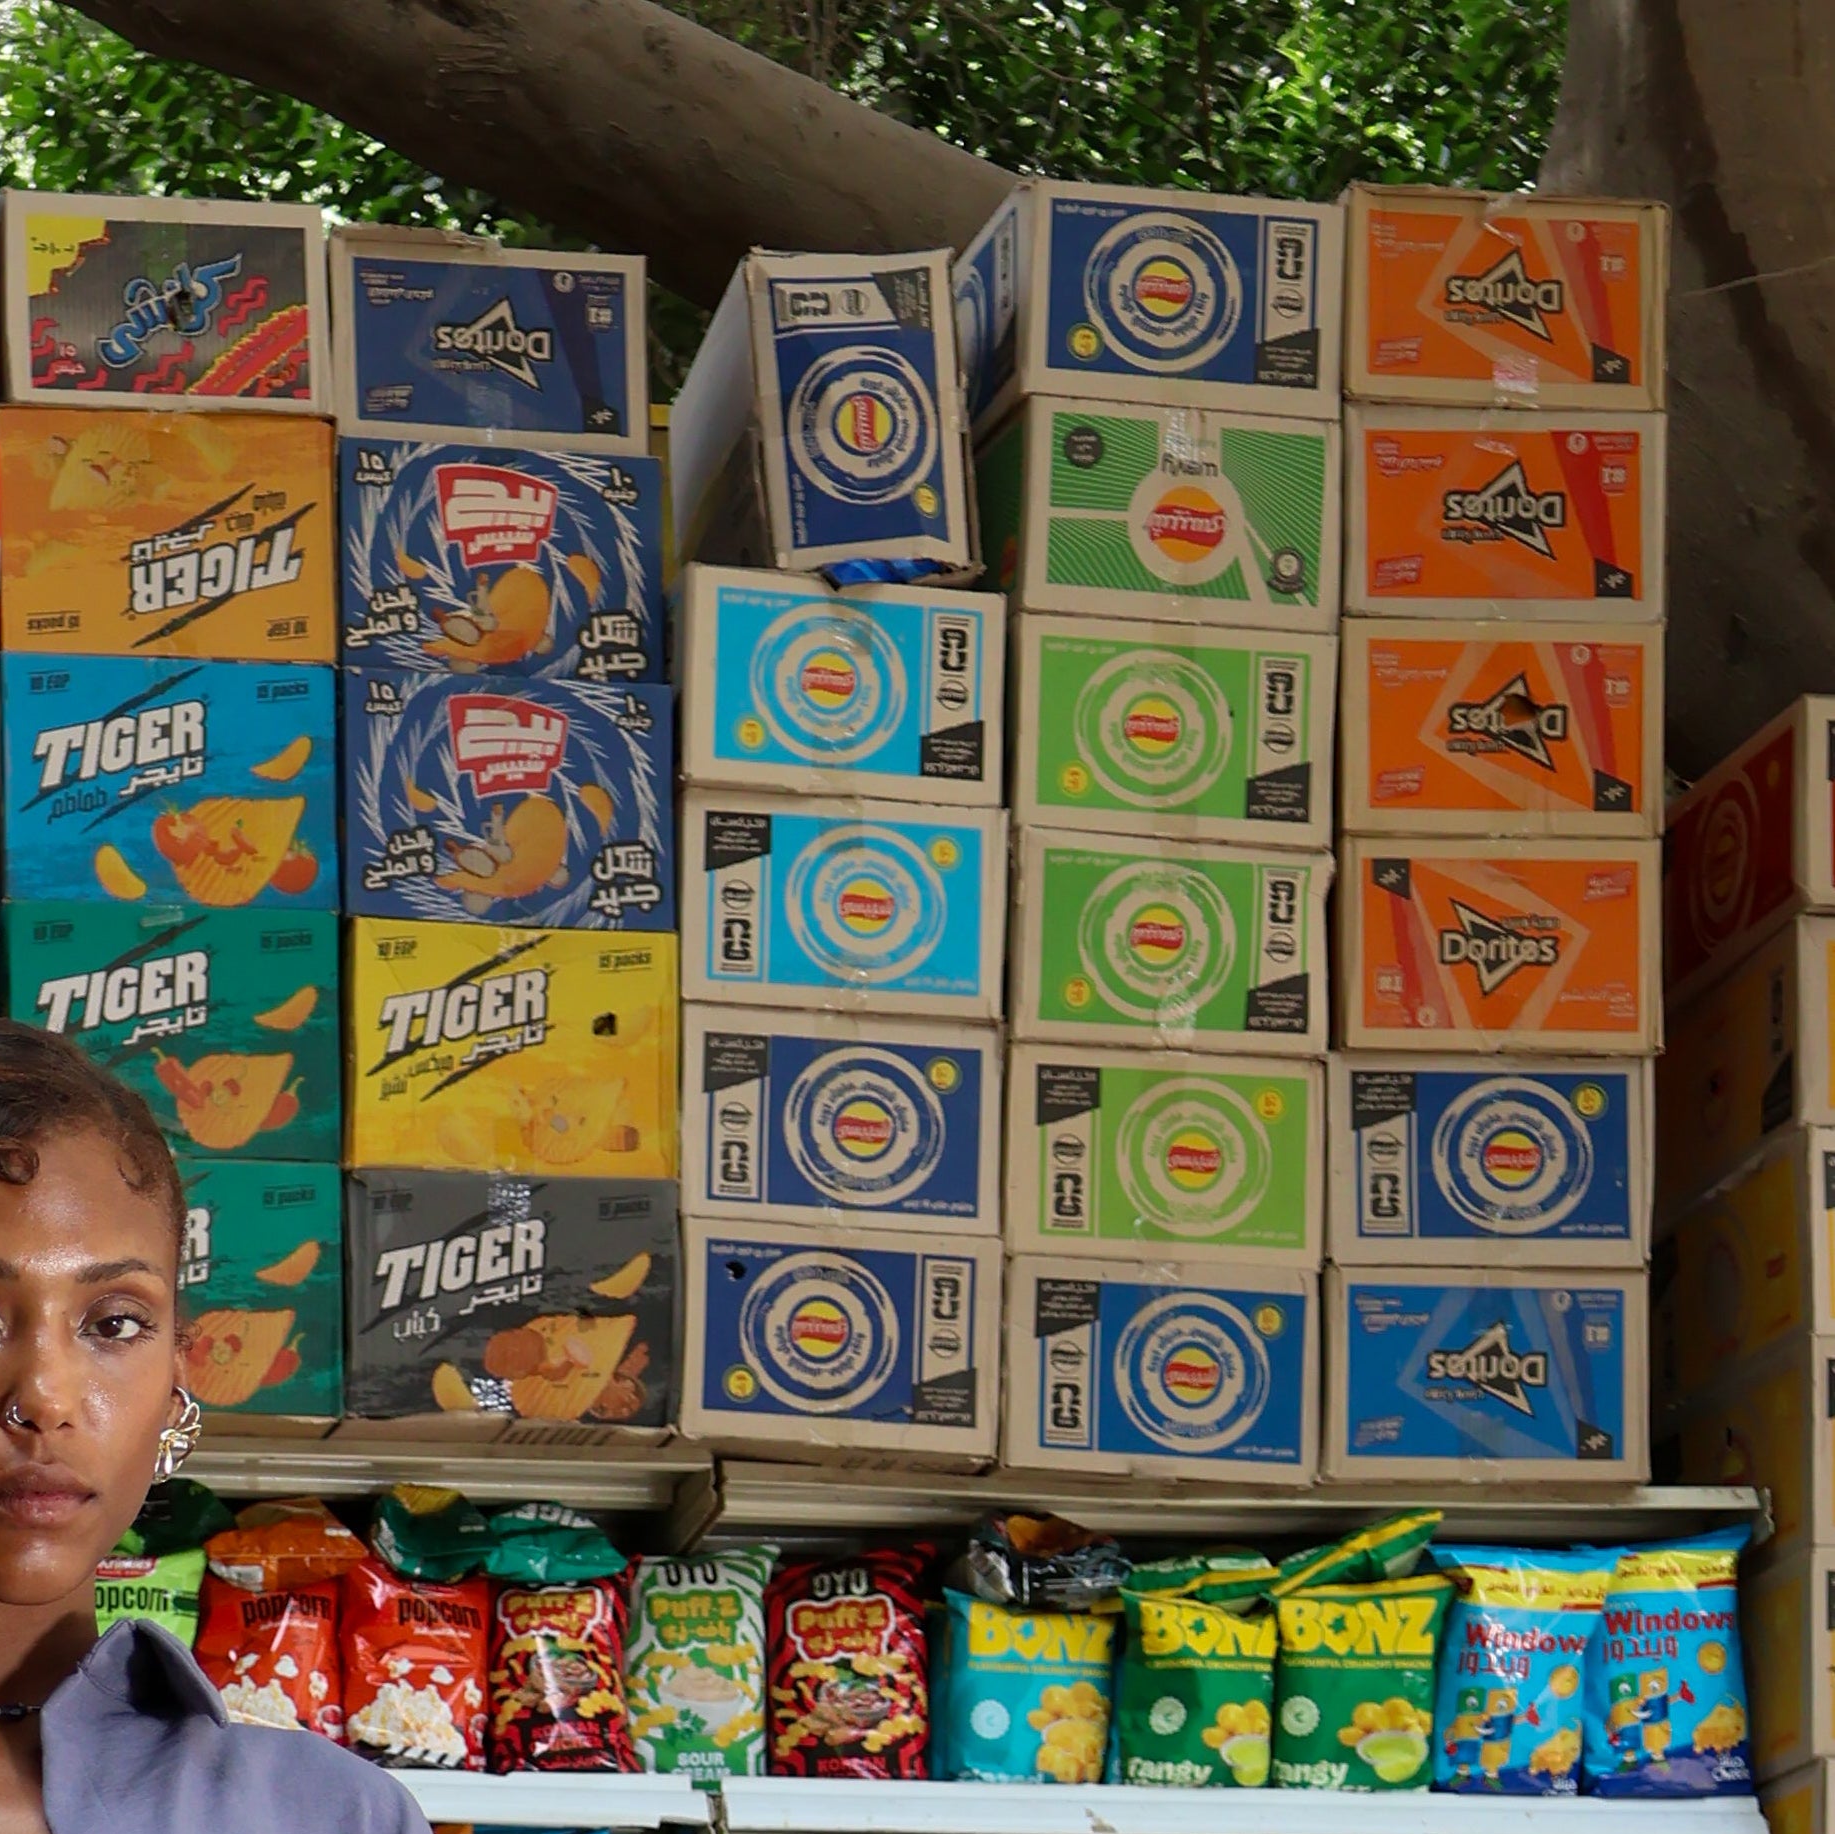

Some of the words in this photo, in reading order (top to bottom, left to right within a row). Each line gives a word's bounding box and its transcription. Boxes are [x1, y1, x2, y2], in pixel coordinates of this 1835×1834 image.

[434, 321, 551, 359] Doritos
[1446, 491, 1563, 527] Doritos
[128, 528, 302, 616] TIGER
[34, 700, 206, 792] TIGER
[1441, 933, 1559, 965] Doritos
[38, 951, 211, 1036] TIGER
[380, 970, 551, 1056] TIGER
[376, 1217, 546, 1309] TIGER
[397, 1594, 484, 1628] popcorn
[968, 1601, 1118, 1660] BONZ
[1279, 1598, 1436, 1657] BONZ
[677, 1751, 725, 1768] SOUR
